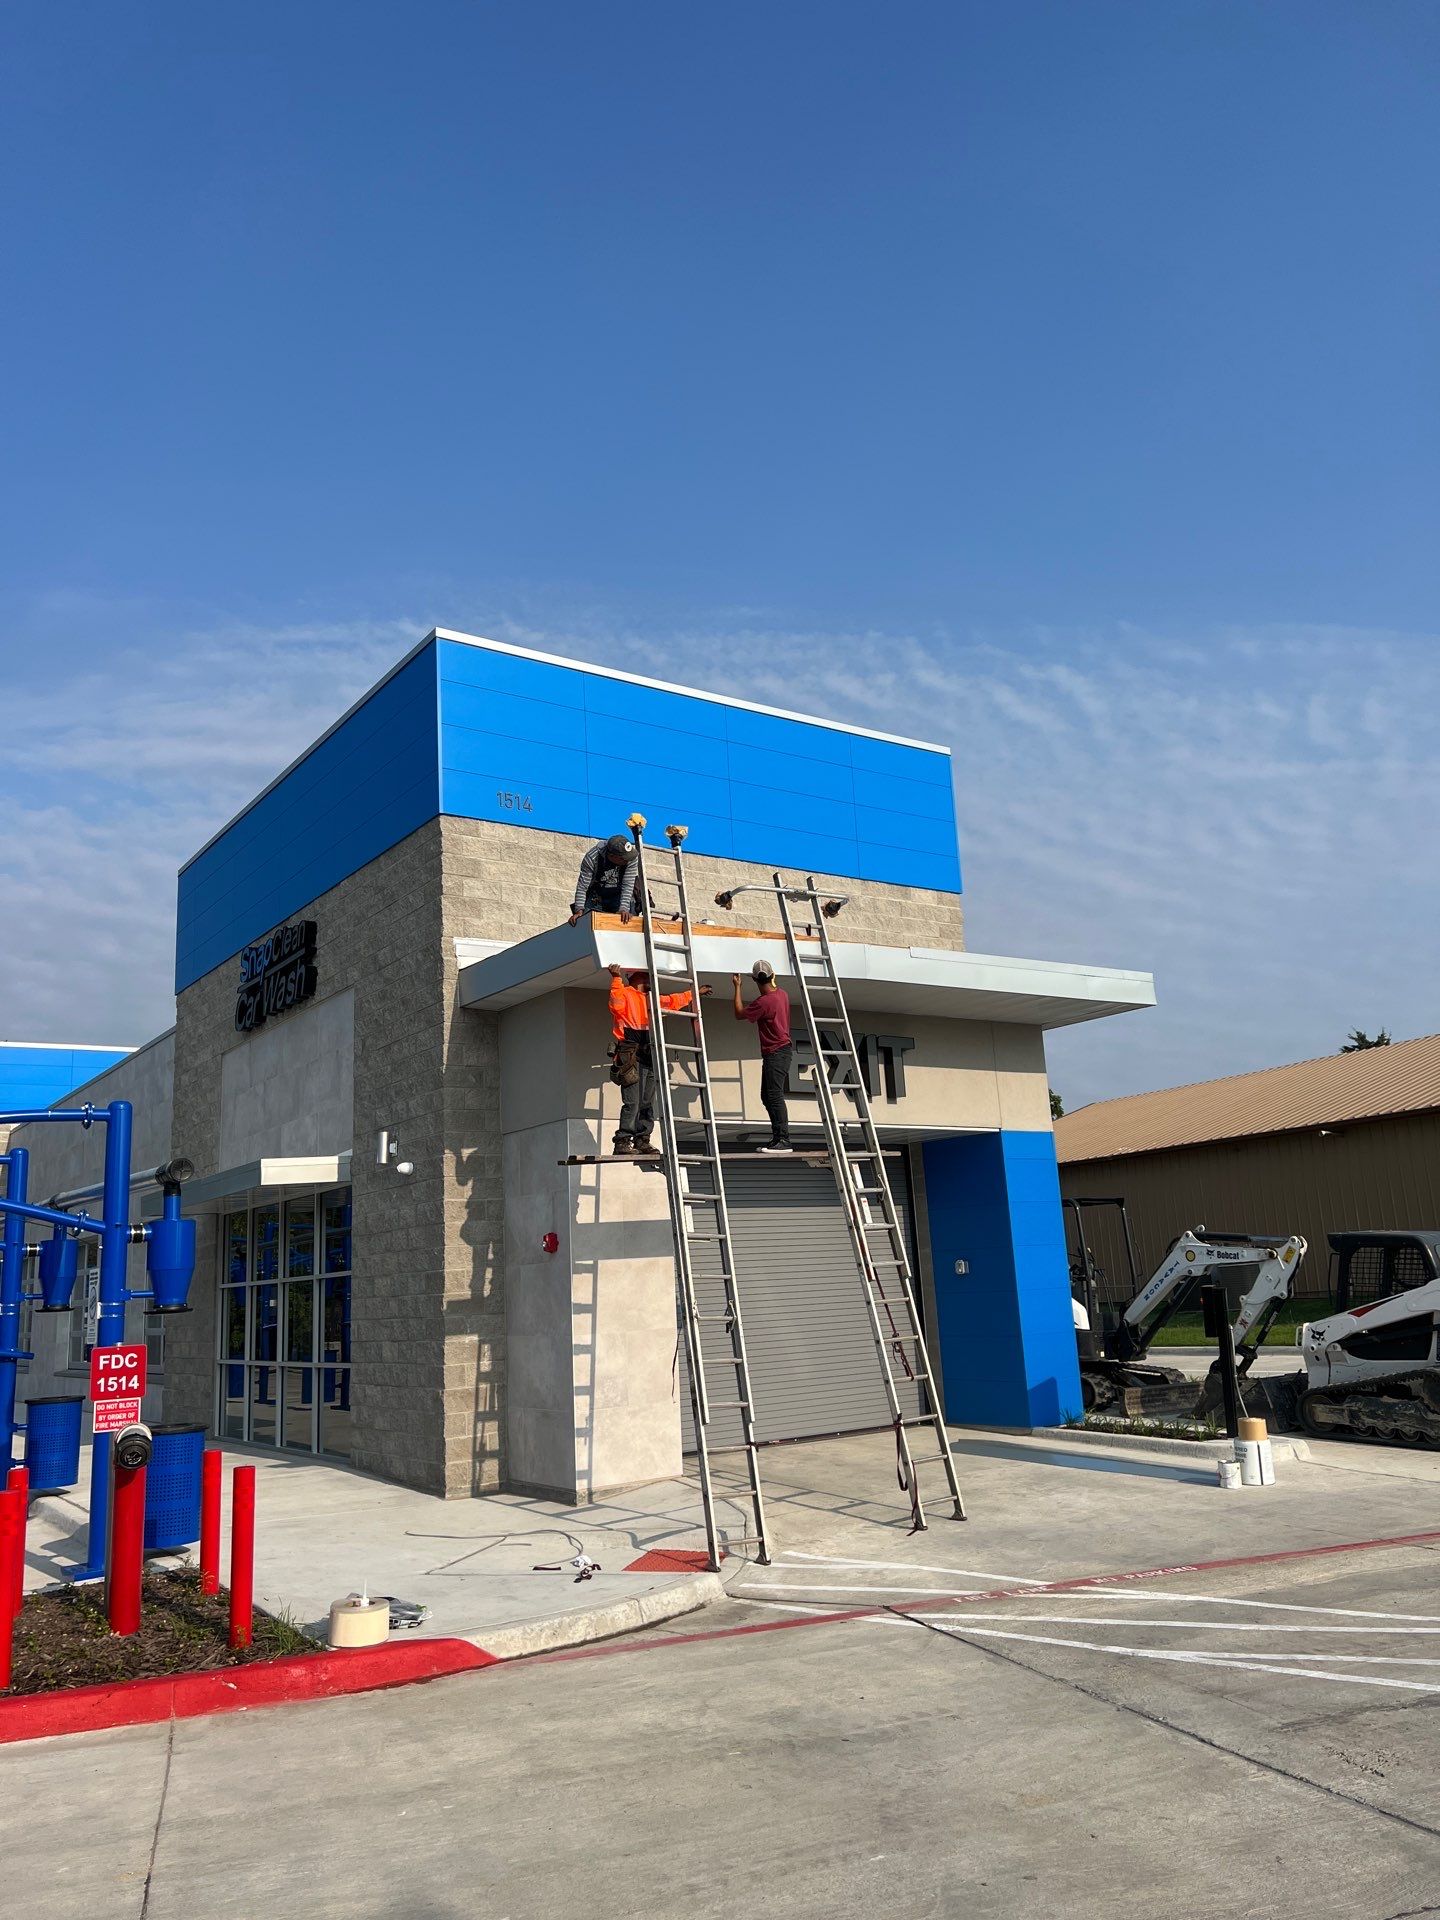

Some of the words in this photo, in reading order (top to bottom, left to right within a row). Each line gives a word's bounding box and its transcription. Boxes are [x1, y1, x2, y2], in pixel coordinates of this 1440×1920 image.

[496, 792, 534, 812] 1514
[240, 920, 307, 985] SnapClean
[235, 992, 261, 1031] Car
[262, 958, 307, 1013] Wash
[787, 1028, 915, 1098] EXIT
[1216, 1250, 1240, 1260] Bobcat
[99, 1353, 138, 1370] FDC
[97, 1375, 140, 1392] 1514
[119, 1401, 138, 1409] BLOCK
[1002, 1586, 1054, 1596] LANE
[1123, 1566, 1198, 1579] PARKING
